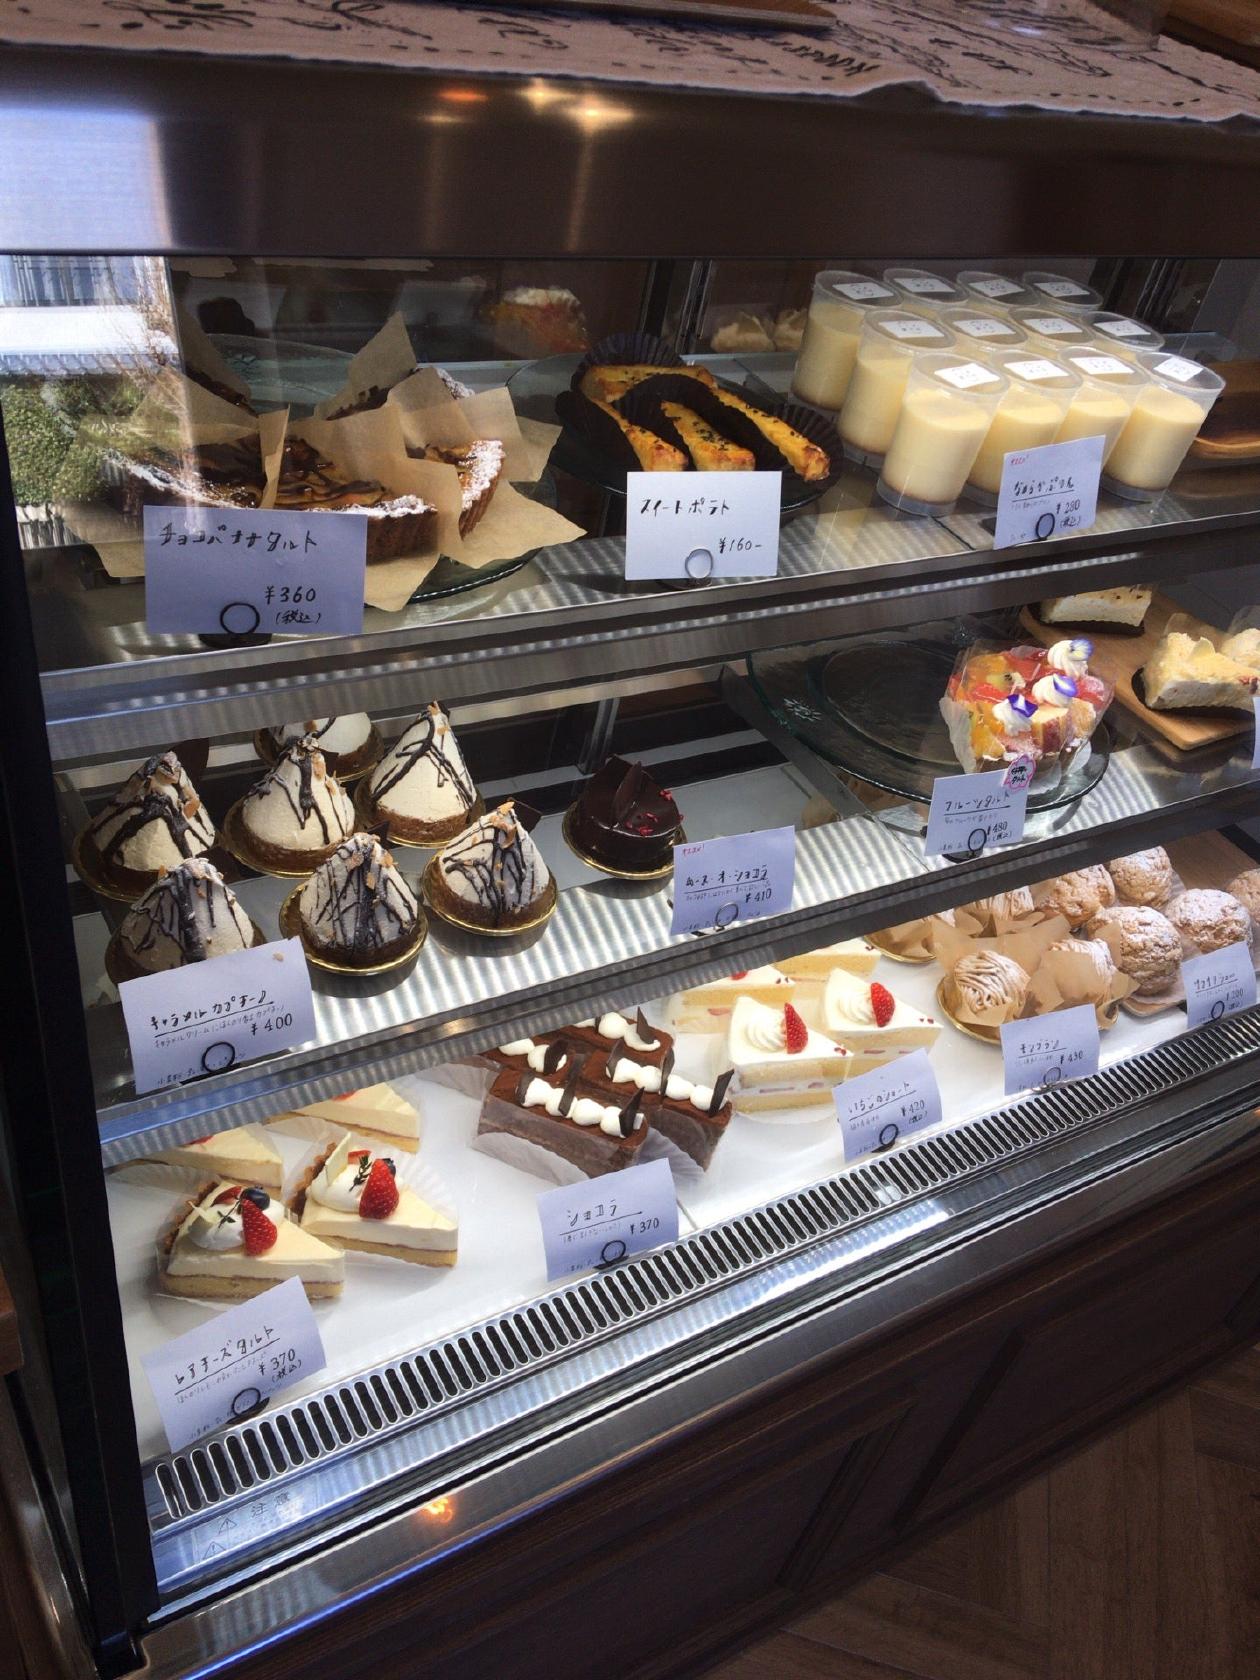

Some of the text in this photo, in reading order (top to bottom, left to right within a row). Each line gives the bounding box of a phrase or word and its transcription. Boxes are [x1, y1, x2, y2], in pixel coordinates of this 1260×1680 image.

[640, 497, 730, 517] スイートポテト
[159, 522, 318, 552] チョコバナナタルト
[264, 585, 317, 605] ¥360
[275, 609, 322, 625] (税込)
[745, 888, 772, 904] ¥410
[250, 1013, 293, 1036] ¥400
[1020, 1039, 1060, 1054] モンブラン
[901, 1100, 925, 1117] ¥420
[567, 1199, 617, 1227] ショコラ
[630, 1218, 660, 1235] ¥370
[175, 1325, 274, 1385] レアチーズタルト
[258, 1348, 296, 1377] ¥370
